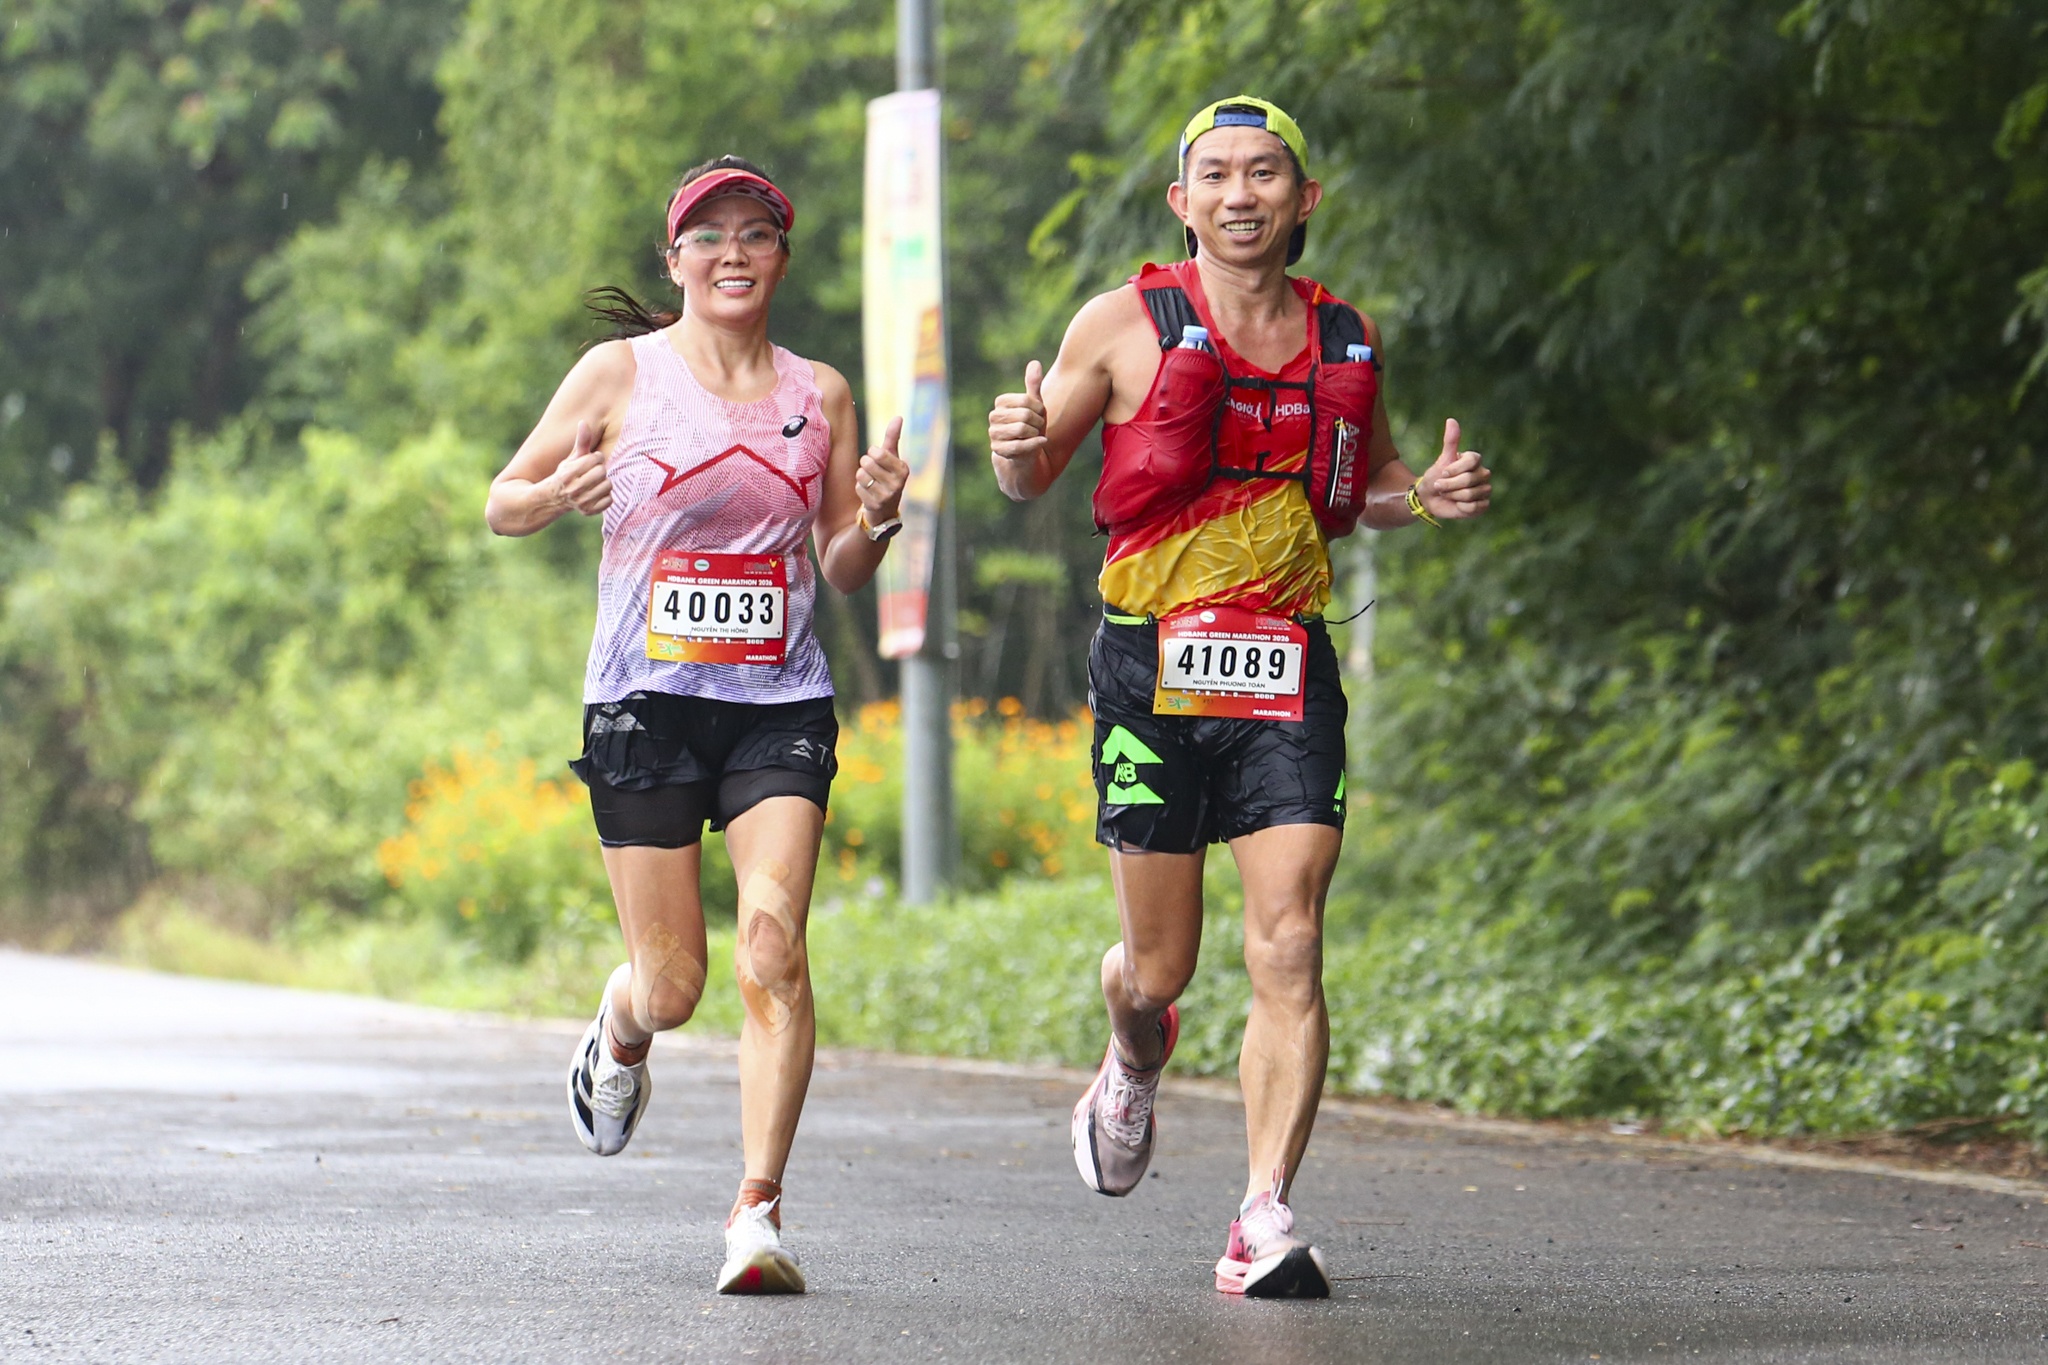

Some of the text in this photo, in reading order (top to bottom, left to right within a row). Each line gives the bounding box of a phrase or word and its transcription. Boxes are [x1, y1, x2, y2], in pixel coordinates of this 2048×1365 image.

[667, 575, 696, 584] HDBANK
[697, 576, 720, 585] GREEN
[721, 577, 757, 586] MARATHON
[664, 589, 774, 625] 40033
[1178, 631, 1208, 639] HDBANK
[1209, 632, 1231, 640] GREEN
[1232, 633, 1271, 641] MARATHON
[745, 653, 778, 661] MARATHON
[1177, 644, 1286, 680] 41089
[1253, 709, 1291, 717] MARATHON
